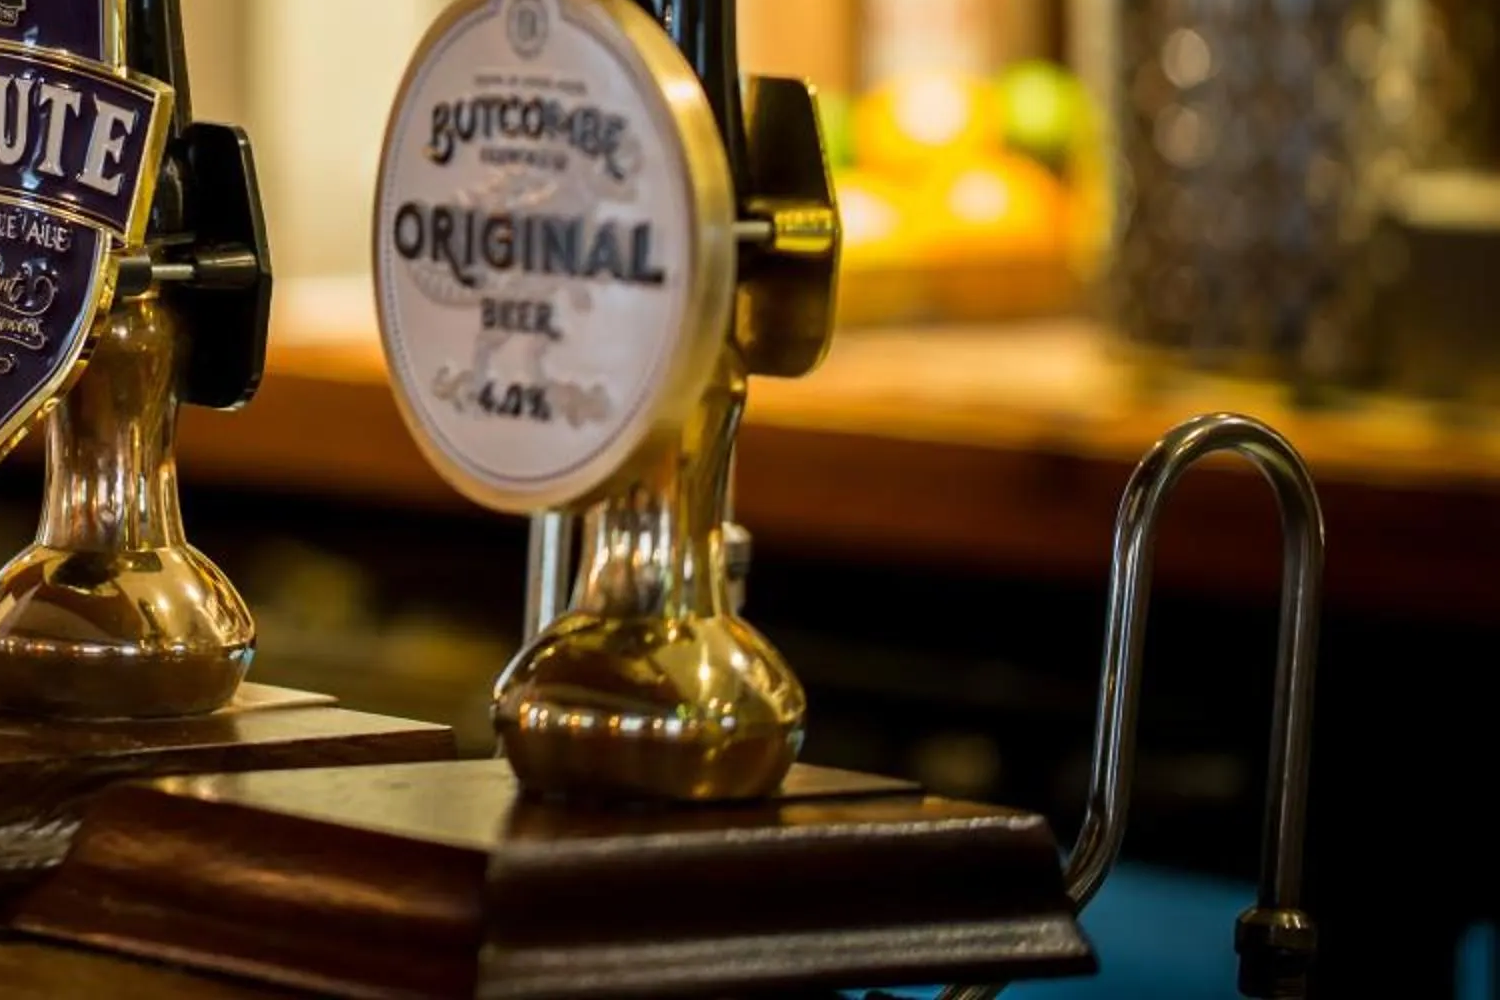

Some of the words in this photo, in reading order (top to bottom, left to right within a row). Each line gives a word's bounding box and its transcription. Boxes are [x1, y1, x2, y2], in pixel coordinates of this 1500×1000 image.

[26, 222, 71, 251] ALE
[394, 202, 666, 287] ORIGINAL
[481, 298, 563, 340] BEER
